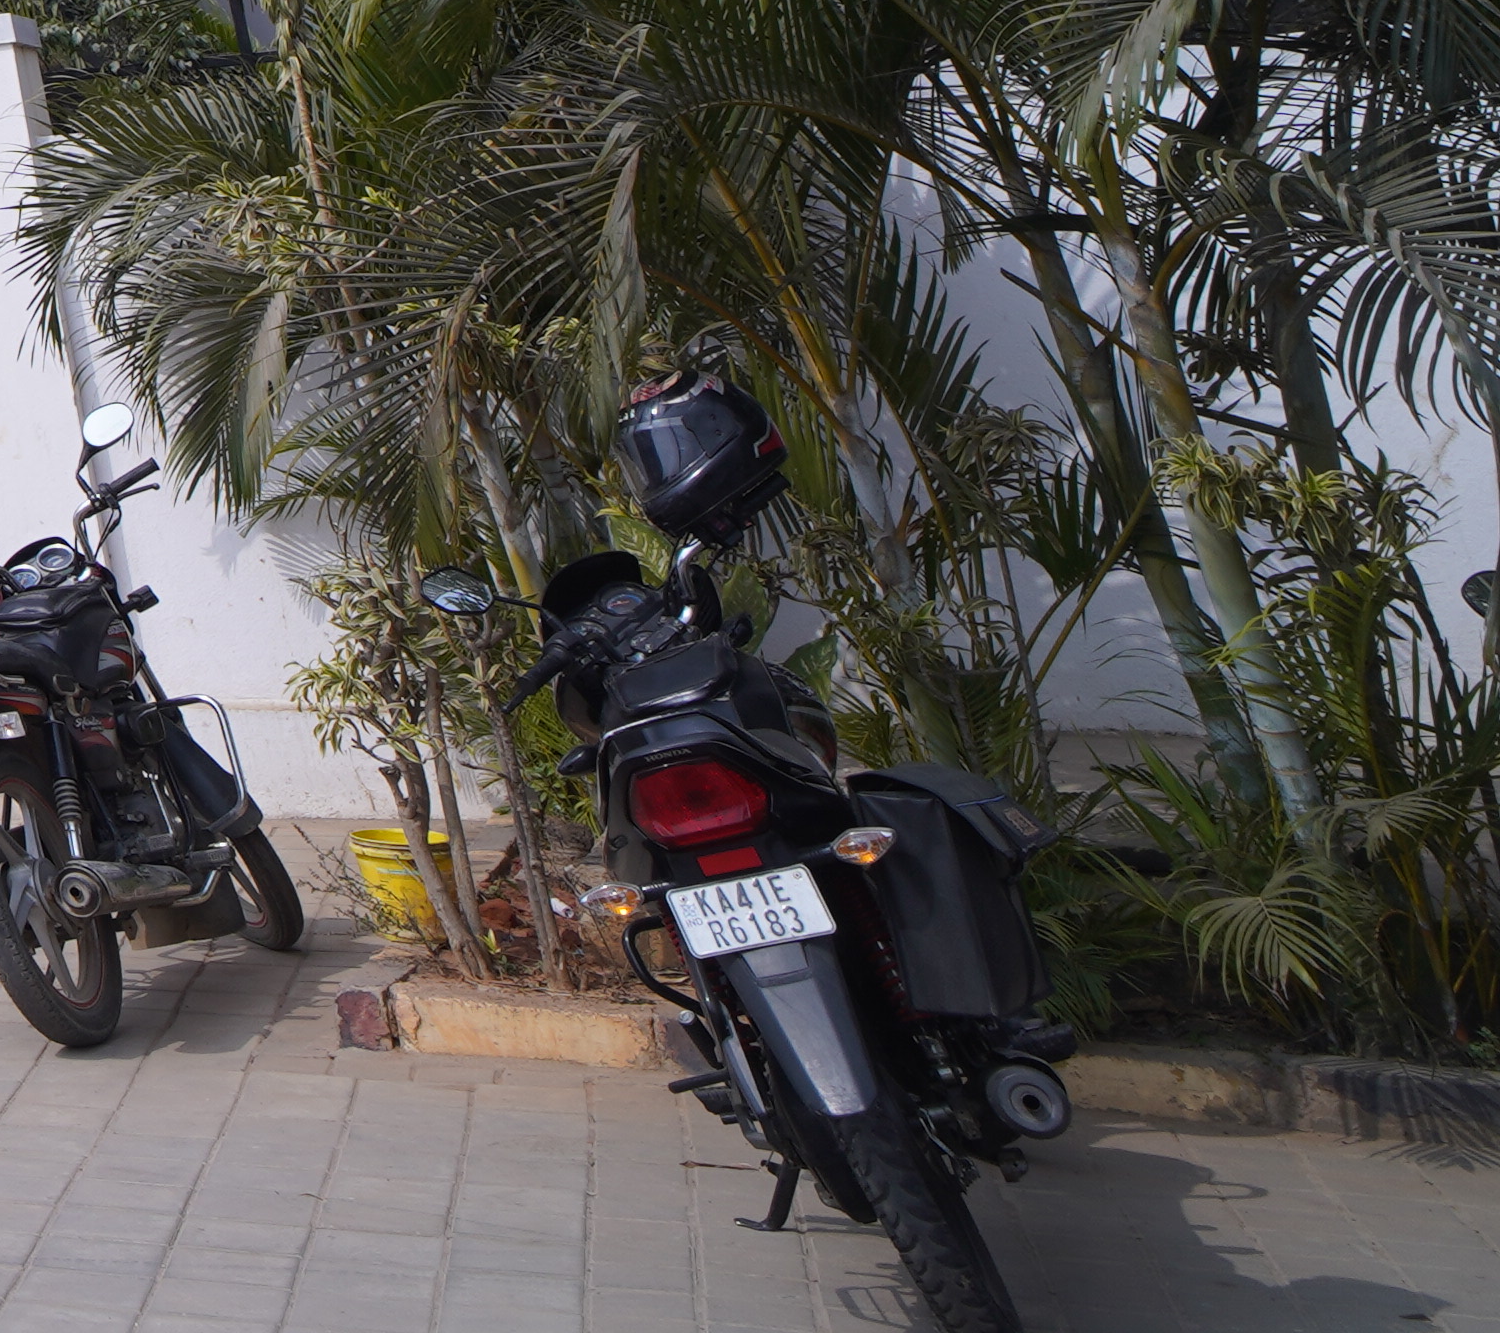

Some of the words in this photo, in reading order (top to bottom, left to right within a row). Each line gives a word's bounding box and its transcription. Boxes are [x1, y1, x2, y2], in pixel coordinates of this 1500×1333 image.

[645, 748, 692, 762] HONDA
[693, 874, 791, 918] KA41E
[707, 905, 806, 949] R6183
